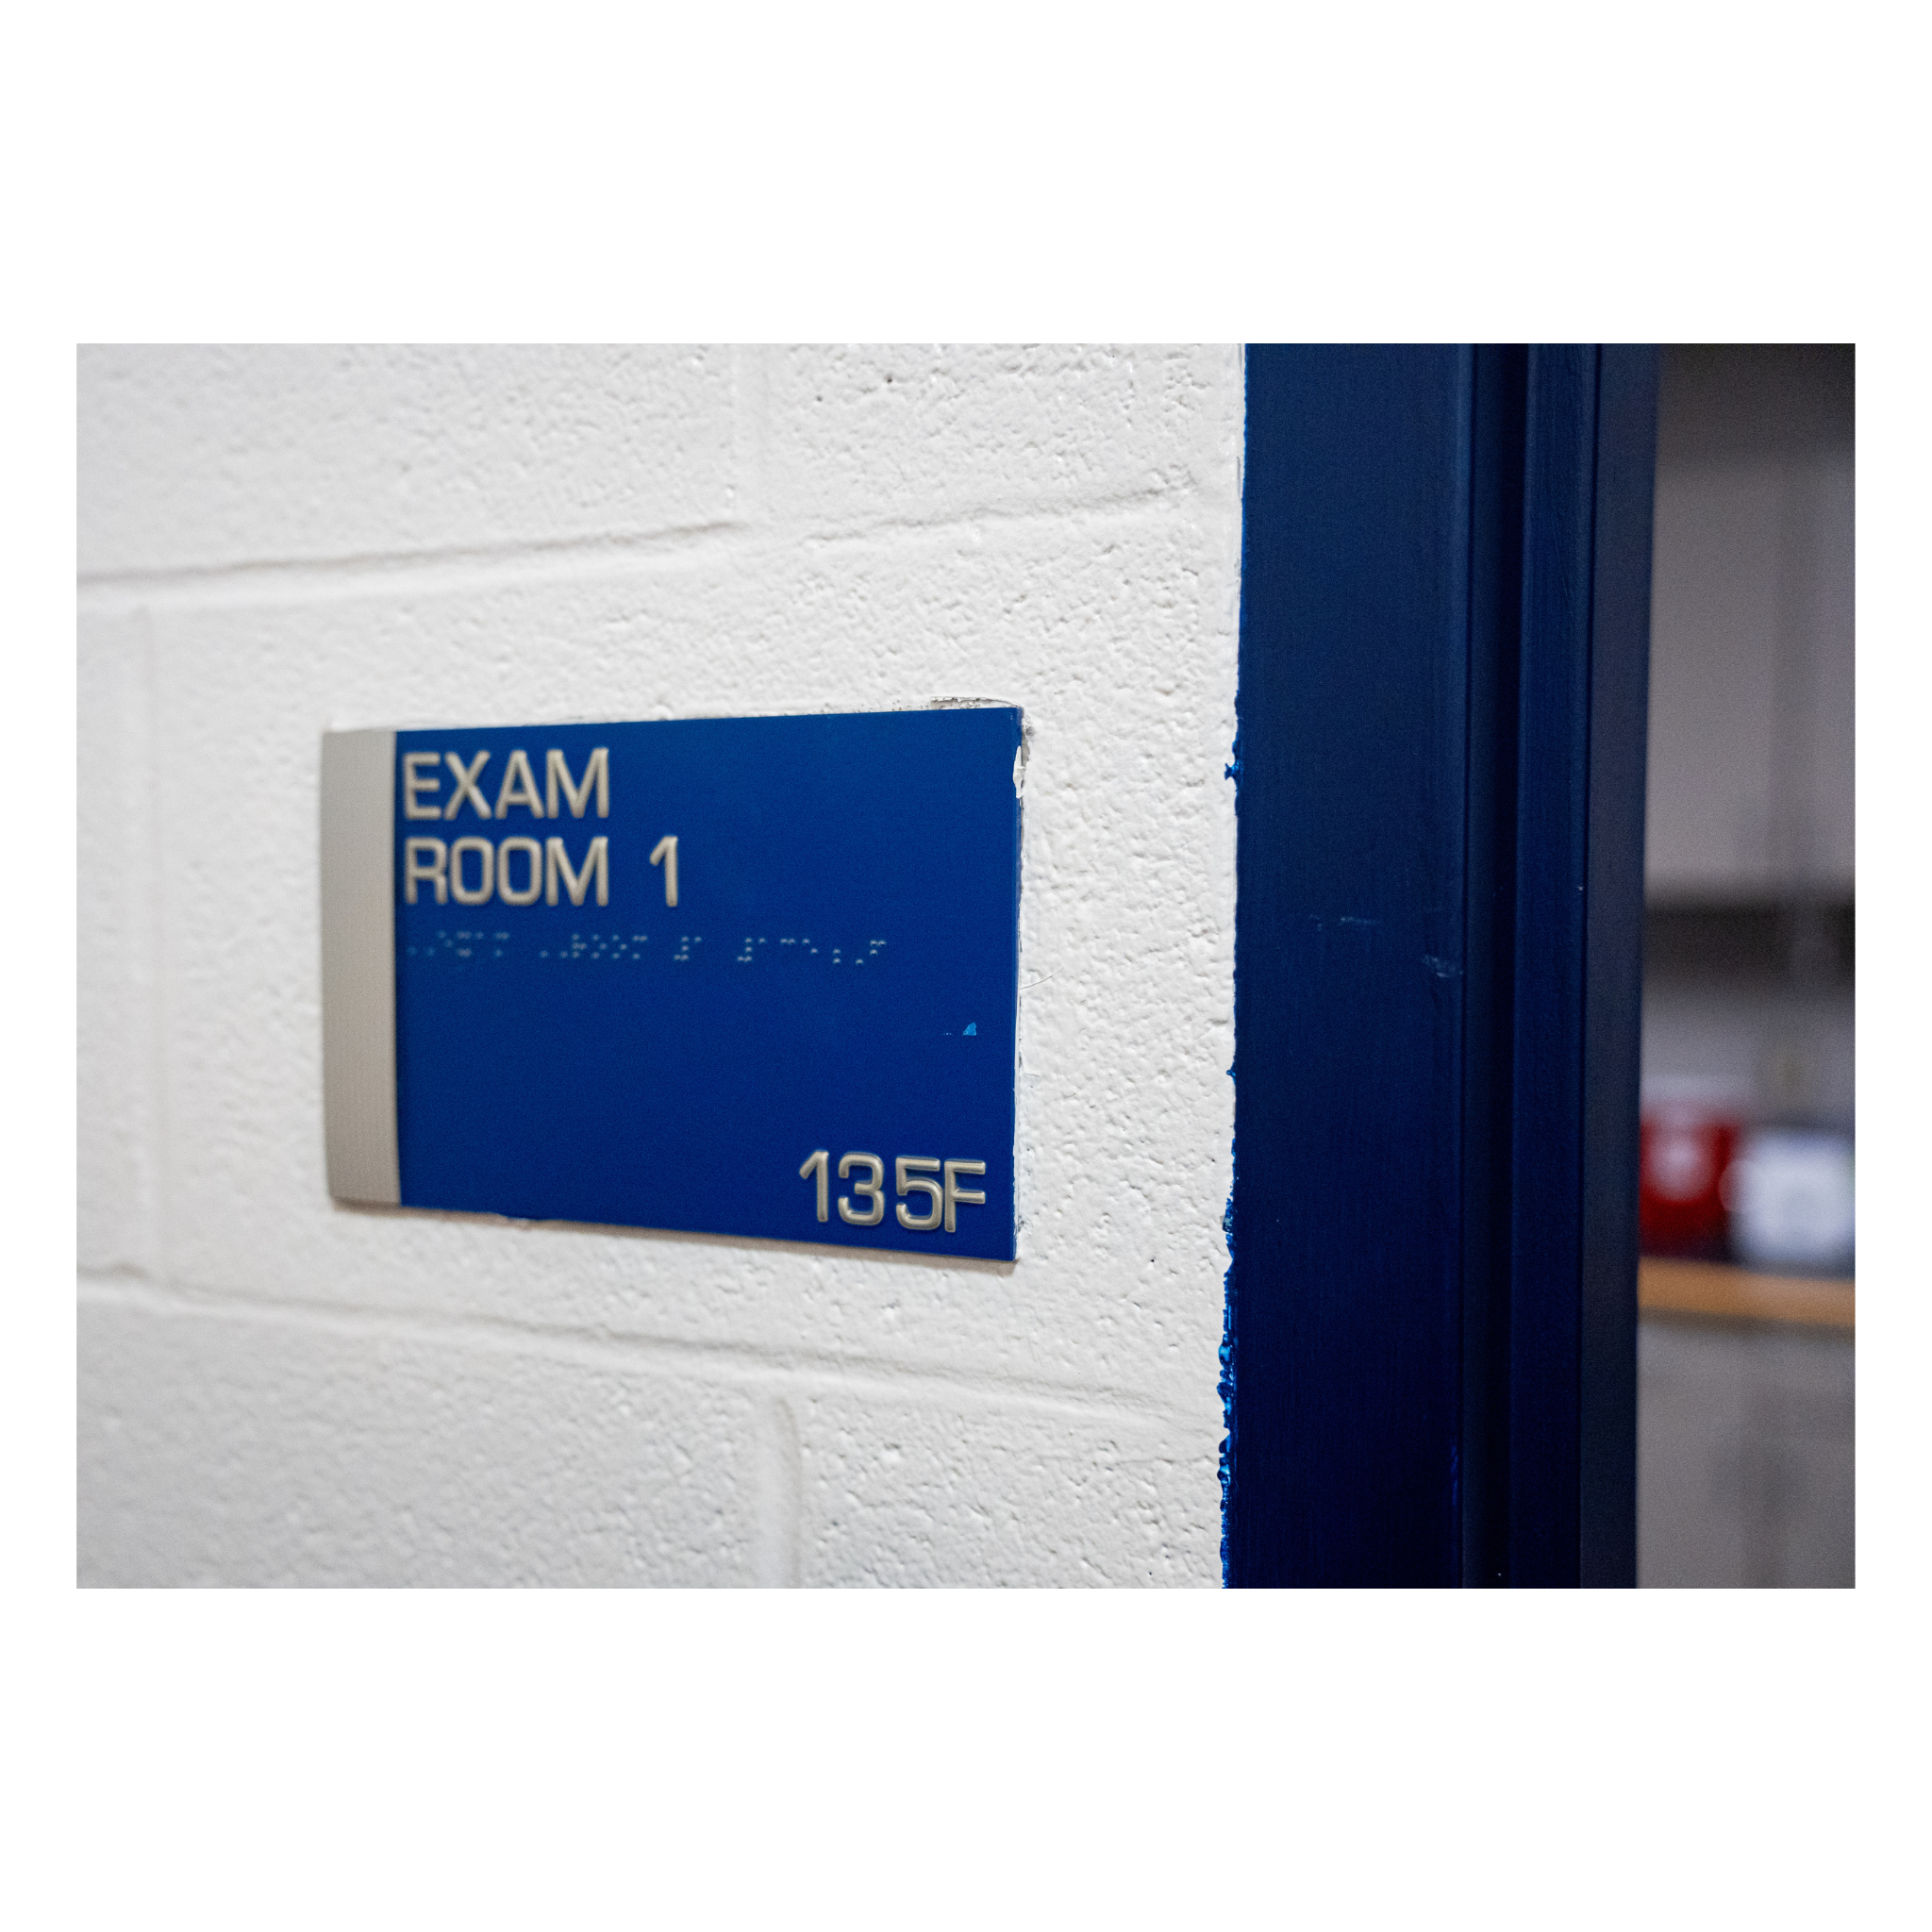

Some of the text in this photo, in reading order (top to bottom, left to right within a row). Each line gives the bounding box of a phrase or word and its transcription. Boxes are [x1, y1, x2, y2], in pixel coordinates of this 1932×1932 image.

[403, 747, 609, 820] EXAM
[404, 836, 678, 908] ROOM 1
[799, 1149, 987, 1233] 135F
